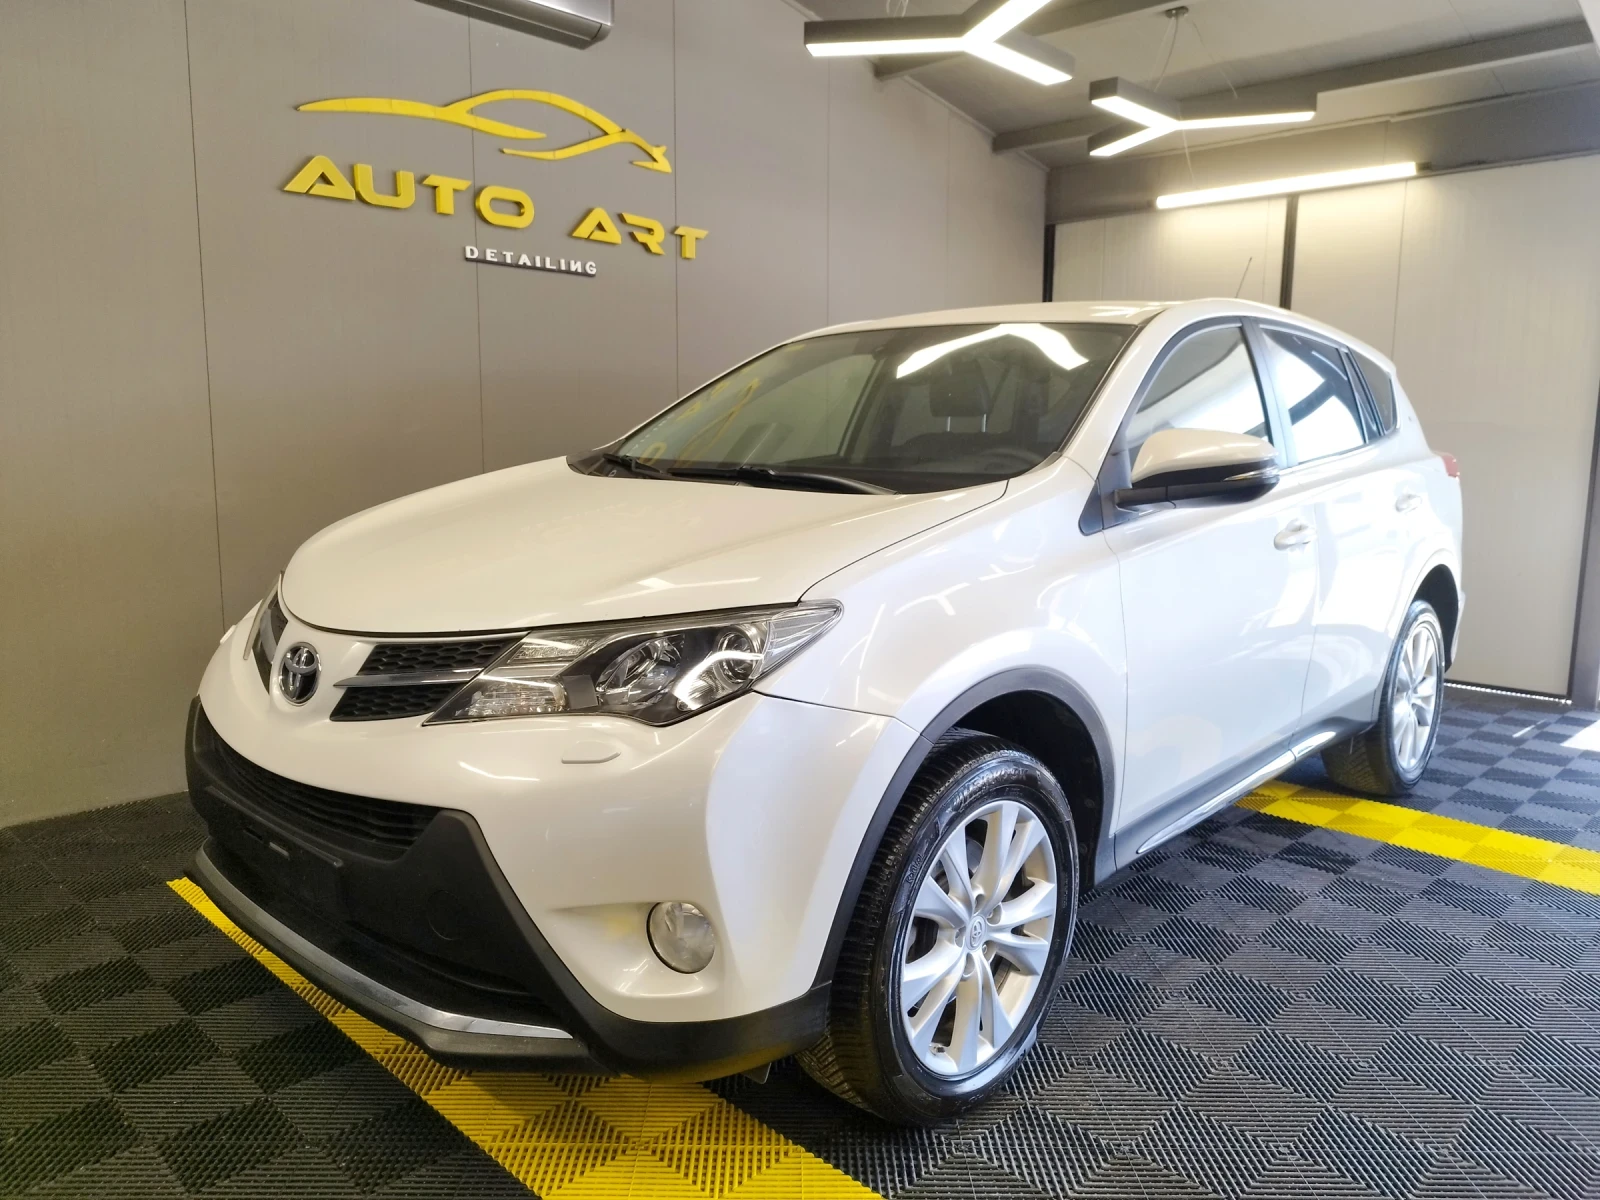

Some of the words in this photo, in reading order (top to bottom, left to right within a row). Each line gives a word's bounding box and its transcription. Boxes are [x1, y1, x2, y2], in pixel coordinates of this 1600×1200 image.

[282, 155, 535, 230] AUTO
[570, 207, 709, 260] ART
[464, 245, 597, 276] DETAILING
